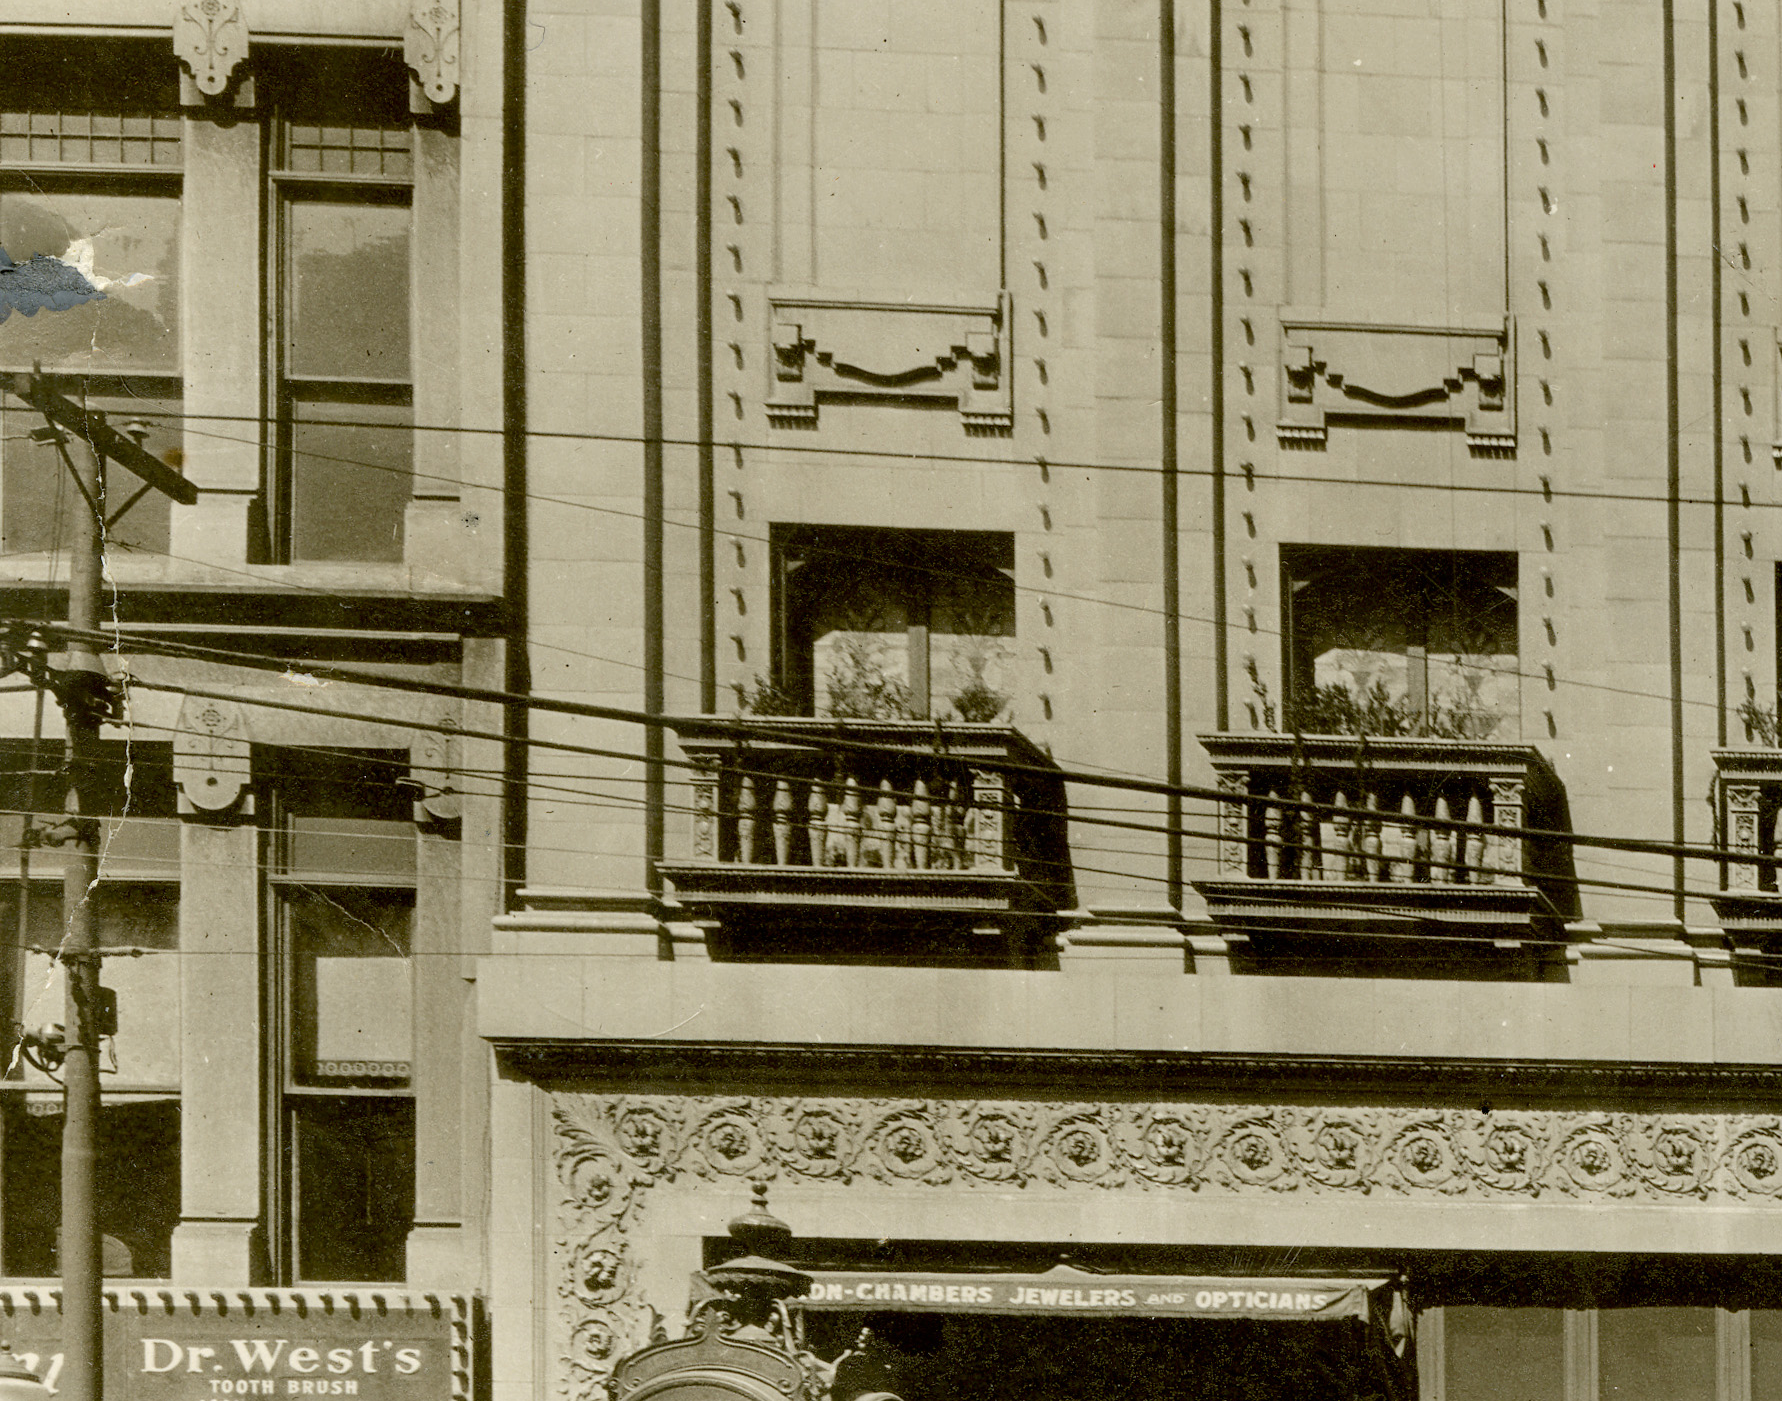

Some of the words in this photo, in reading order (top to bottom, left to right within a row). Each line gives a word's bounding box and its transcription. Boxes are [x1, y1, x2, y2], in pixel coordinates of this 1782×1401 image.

[1009, 1286, 1136, 1308] JEWELERS
[1144, 1293, 1188, 1305] AND
[1195, 1291, 1328, 1310] OPTICIANS
[210, 1379, 275, 1395] TOOTH
[287, 1380, 358, 1396] BRUSH
